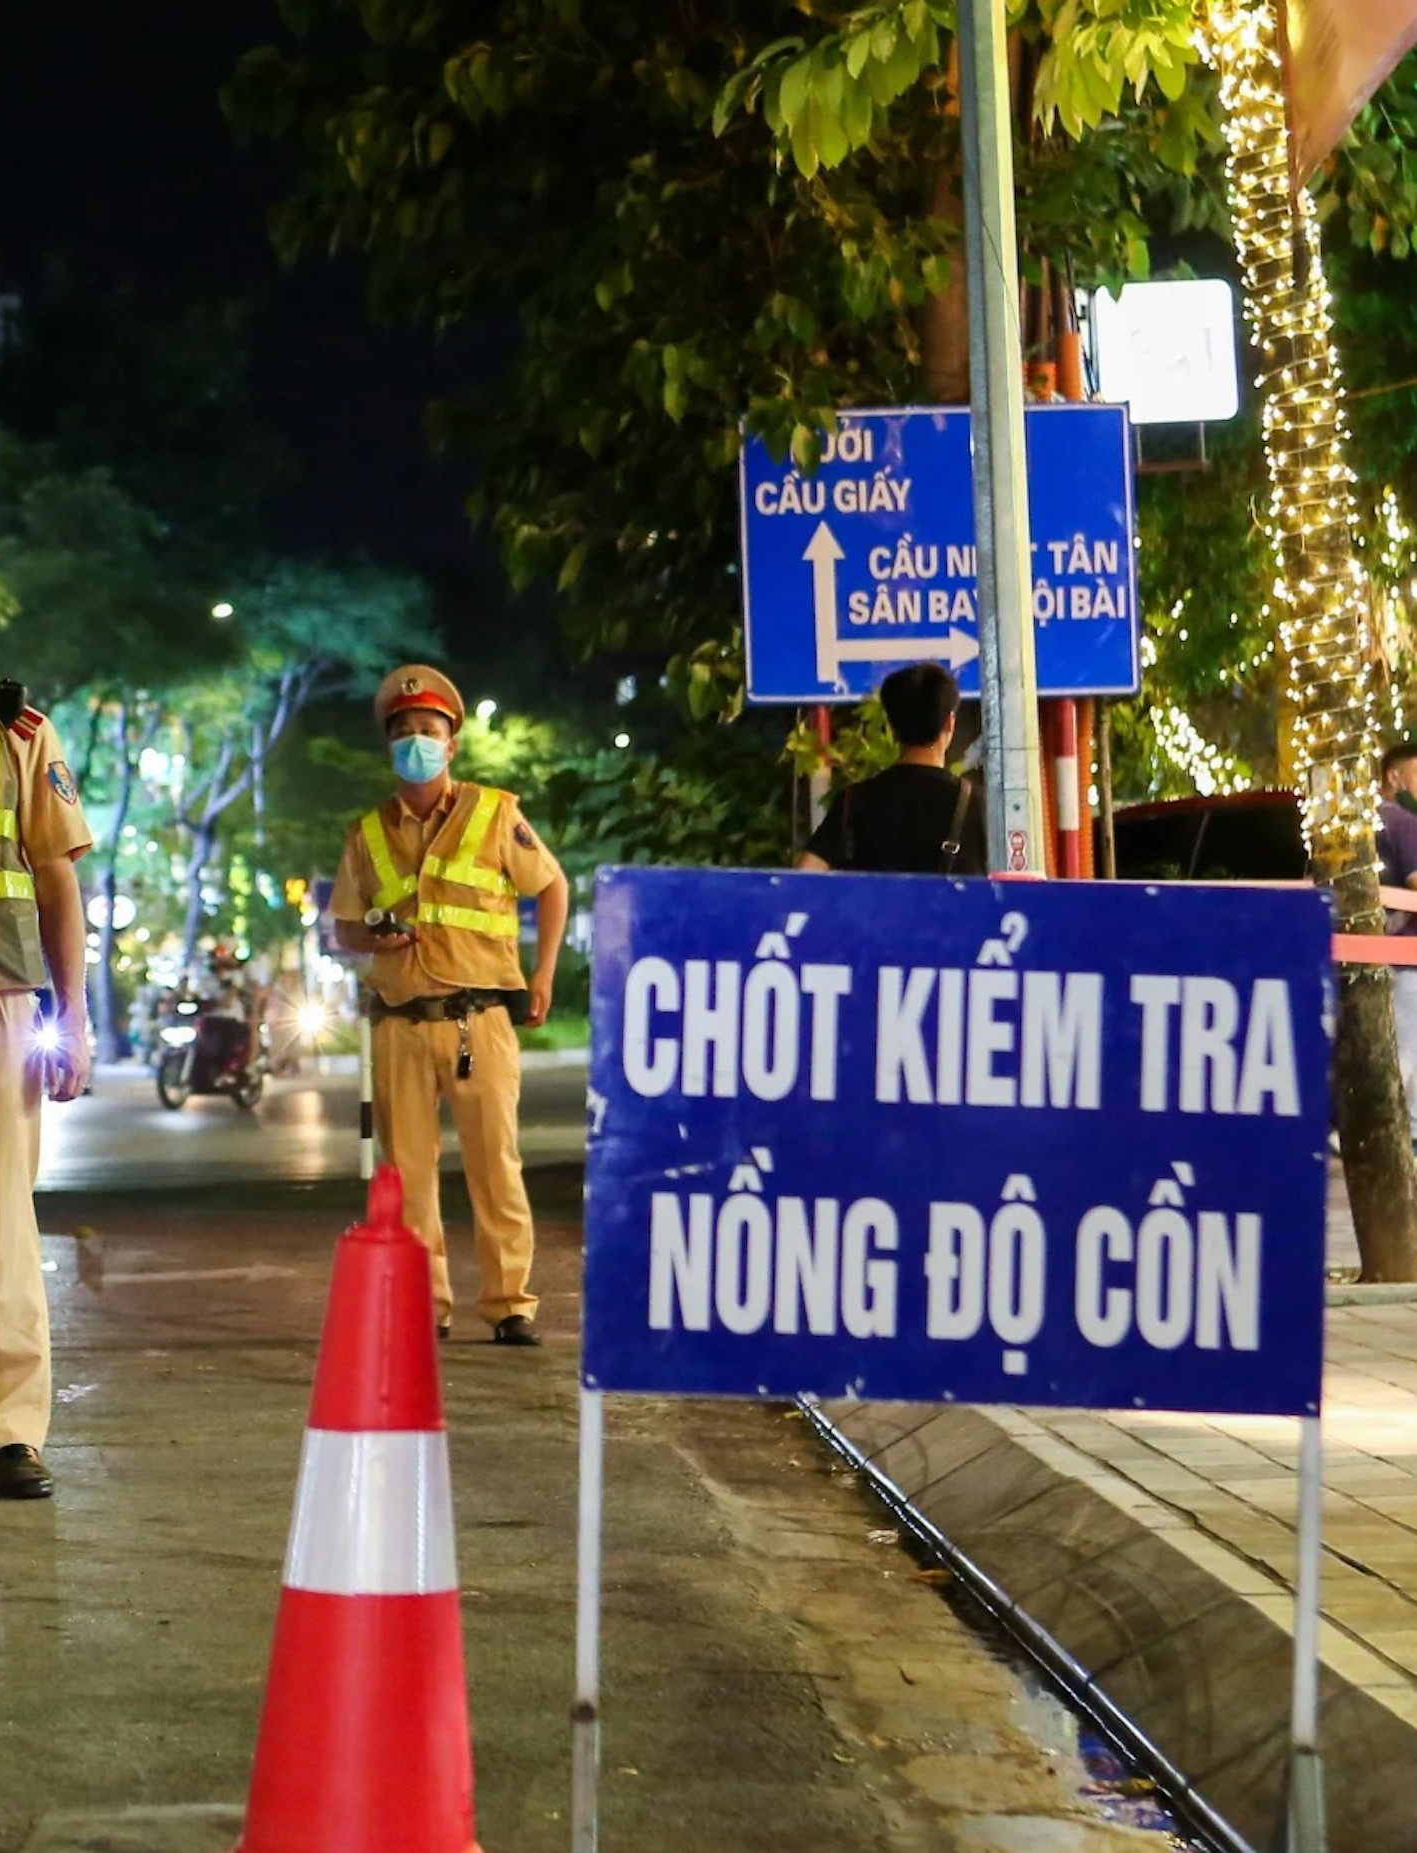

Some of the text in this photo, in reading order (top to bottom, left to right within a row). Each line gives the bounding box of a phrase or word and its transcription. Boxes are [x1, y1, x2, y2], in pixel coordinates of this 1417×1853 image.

[790, 417, 873, 463] ỞI
[755, 464, 912, 515] CẦU GIẤY
[868, 531, 938, 580] CẦU
[1047, 532, 1119, 575] TÂN
[848, 577, 1127, 627] SÂN BA ỘI BÀI
[622, 911, 1301, 1117] CHỐT KIỂM TRA
[648, 1147, 1261, 1375] NỒNG ĐỘ CỒN
